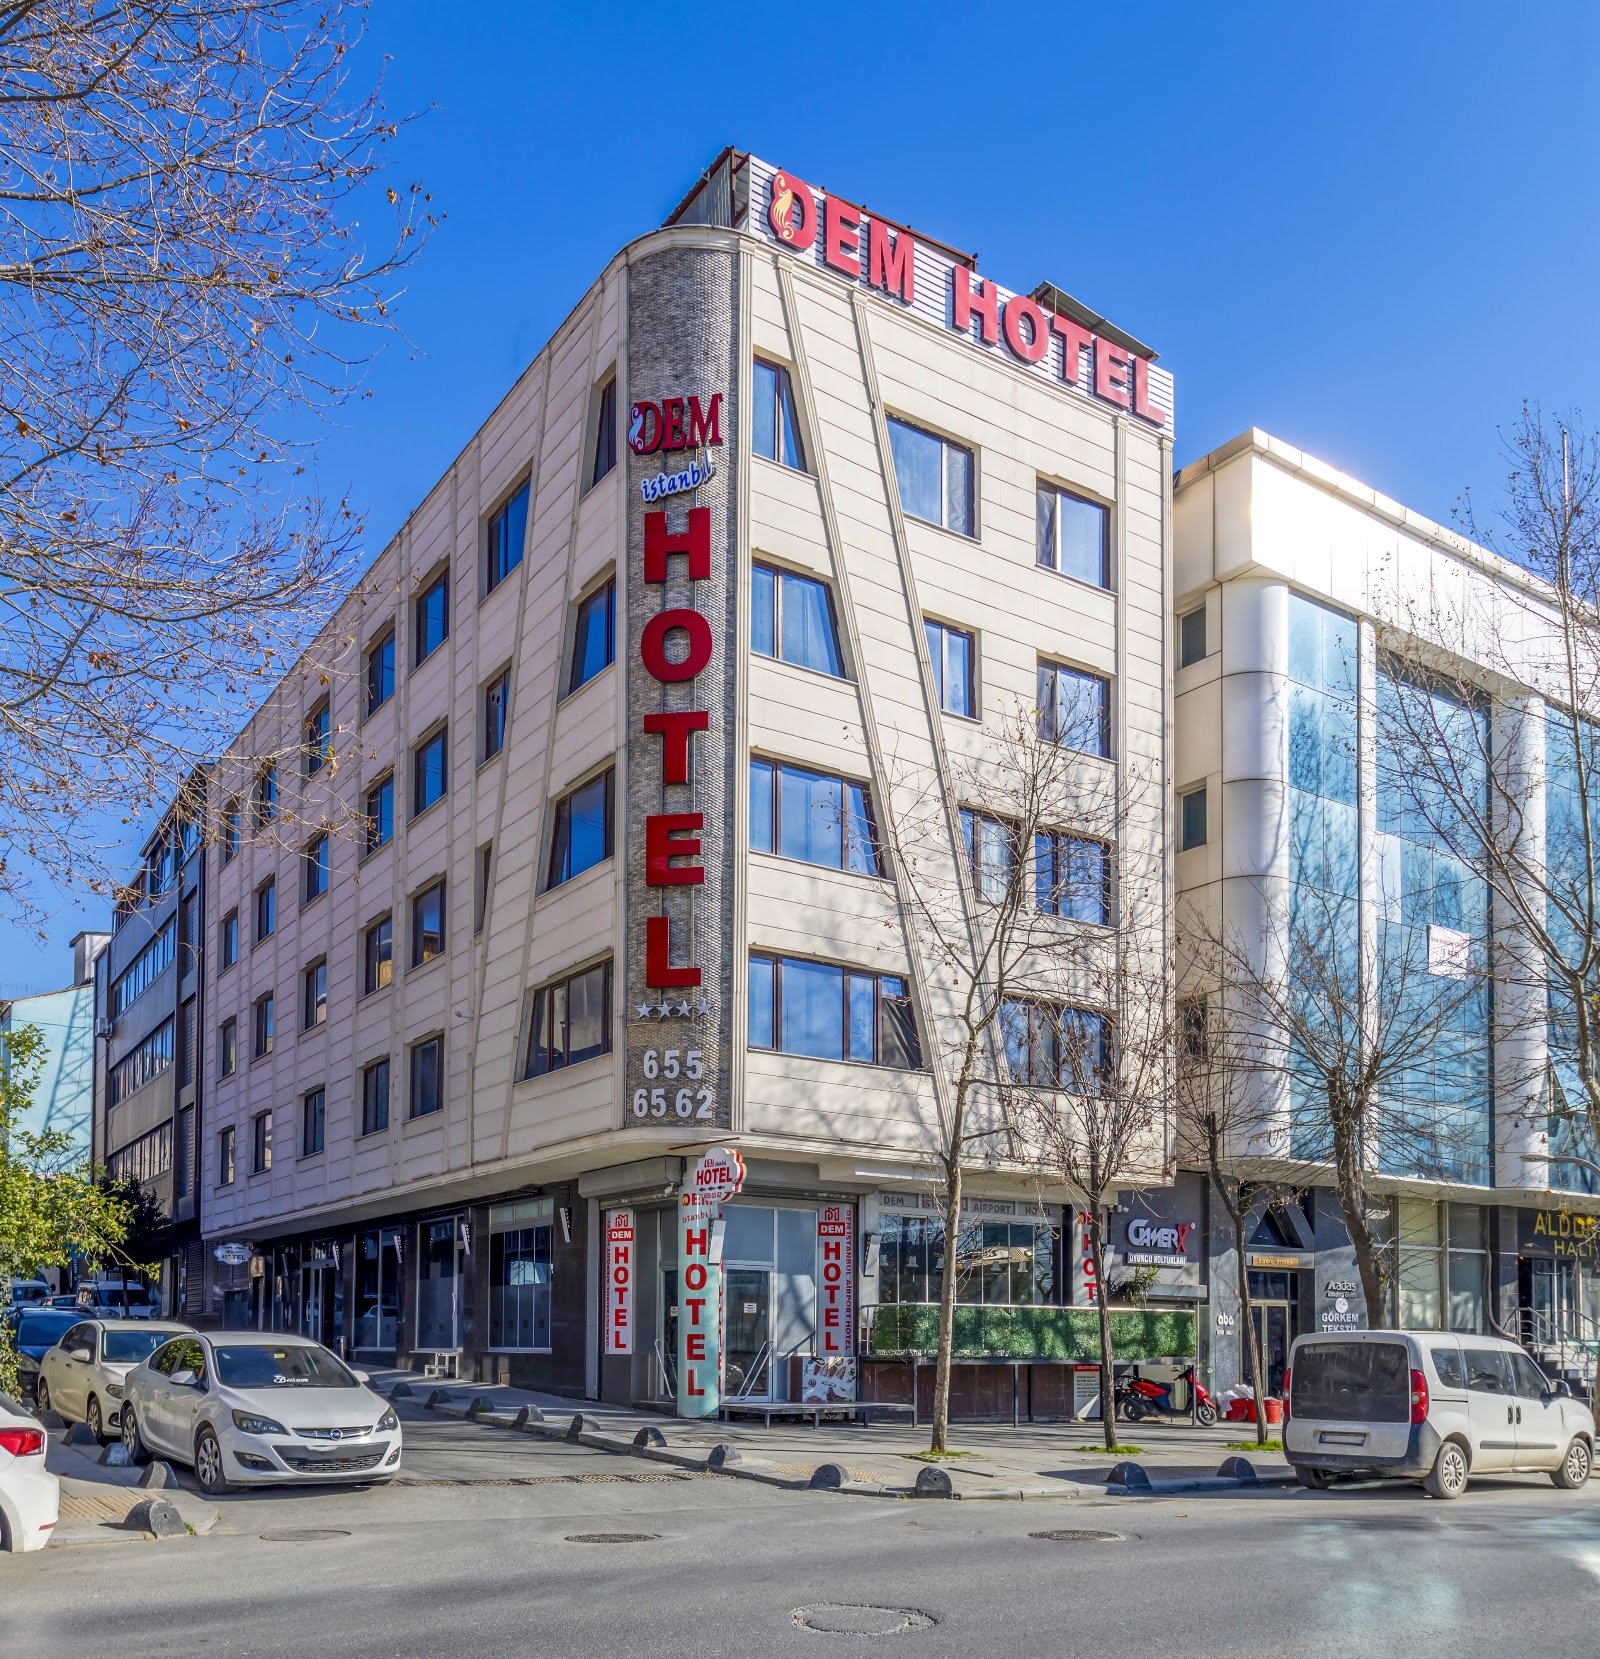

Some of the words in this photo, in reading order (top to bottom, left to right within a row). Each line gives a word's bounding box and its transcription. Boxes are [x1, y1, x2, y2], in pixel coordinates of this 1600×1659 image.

[767, 169, 915, 306] DEM
[952, 264, 1166, 428] HOTEL
[628, 392, 724, 456] DEM
[641, 448, 713, 502] istanbul
[641, 507, 712, 988] HOTEL
[643, 1049, 704, 1079] 655
[696, 1167, 732, 1186] HOTEL
[883, 1195, 904, 1206] DEM
[611, 1230, 632, 1239] DEM
[820, 1224, 844, 1234] DEM
[613, 1246, 629, 1349] HOTEL
[685, 1229, 708, 1396] HOTEL
[823, 1241, 842, 1351] HOTEL
